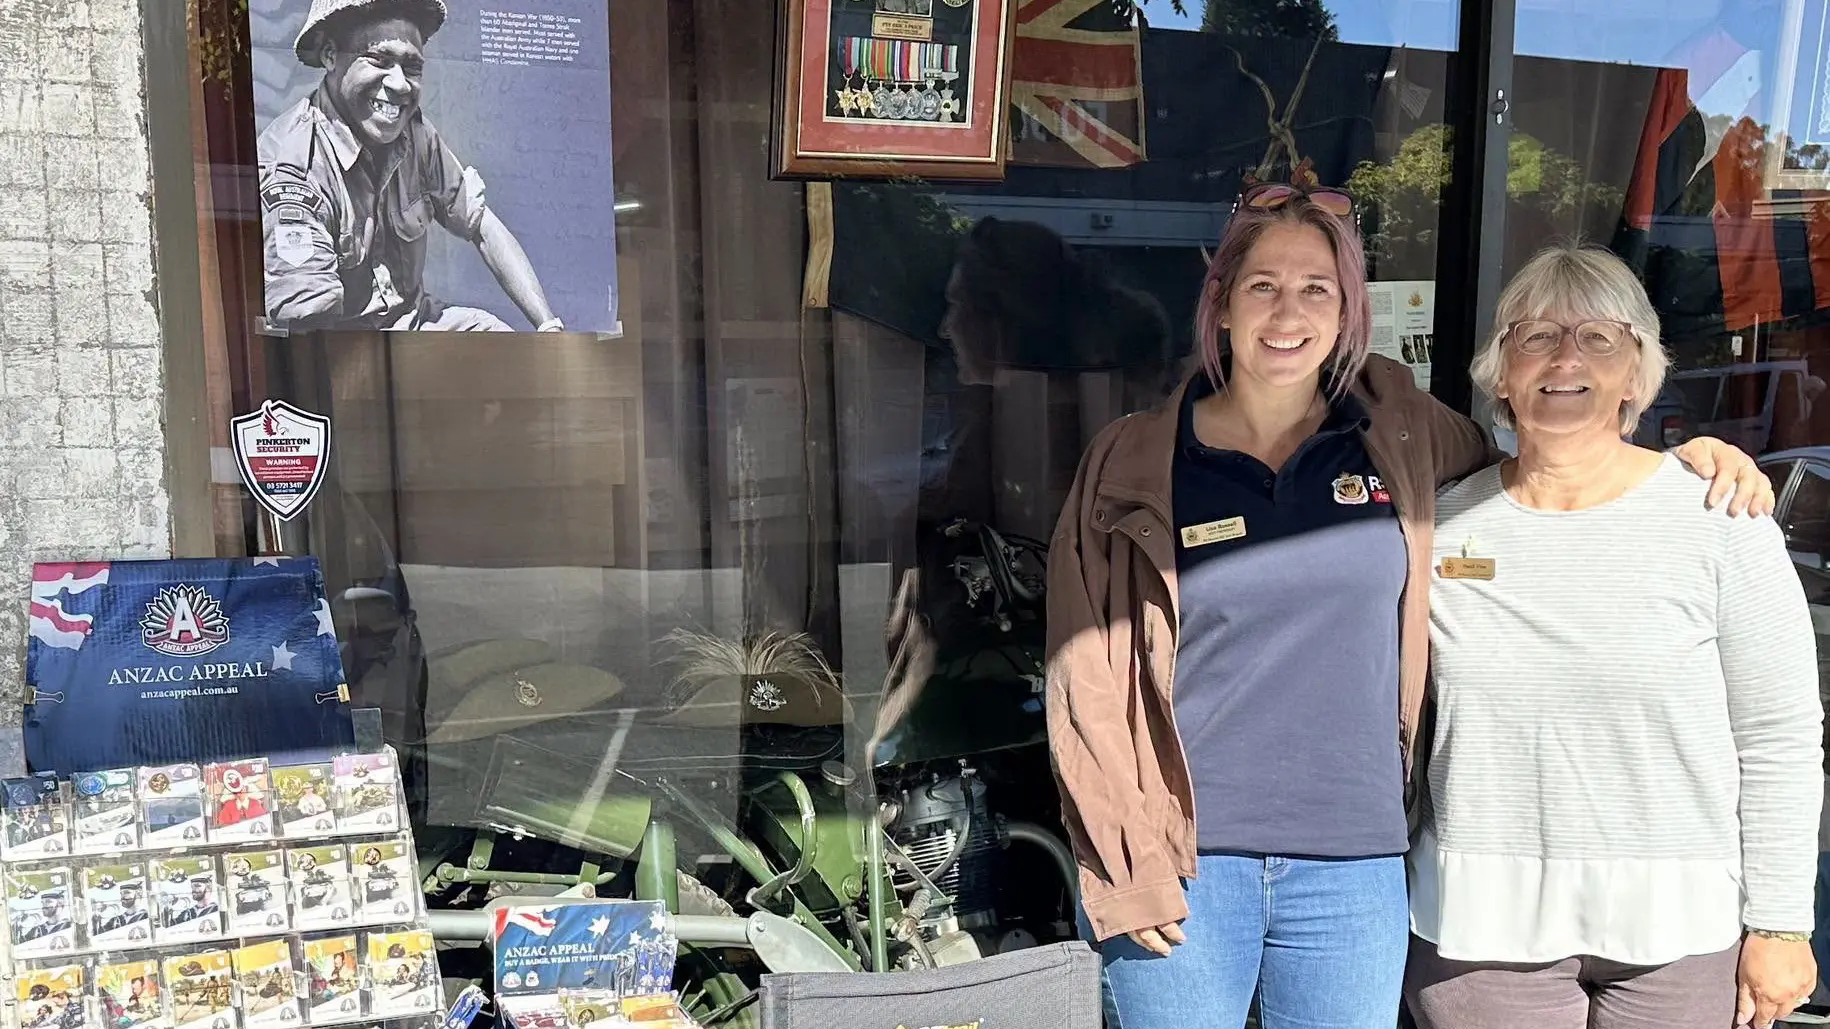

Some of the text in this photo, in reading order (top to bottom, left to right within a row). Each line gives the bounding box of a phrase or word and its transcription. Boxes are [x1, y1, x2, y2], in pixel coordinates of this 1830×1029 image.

[163, 639, 211, 652] ANZAC APPEAL
[108, 662, 268, 685] ANZAC APPEAL
[140, 685, 239, 700] anzacappeal.com.au
[504, 943, 595, 958] ANZAC APPEAL
[504, 959, 518, 967] BUY
[519, 959, 526, 967] A
[550, 956, 571, 964] WEAR
[571, 955, 579, 963] IT
[579, 954, 598, 962] WITH
